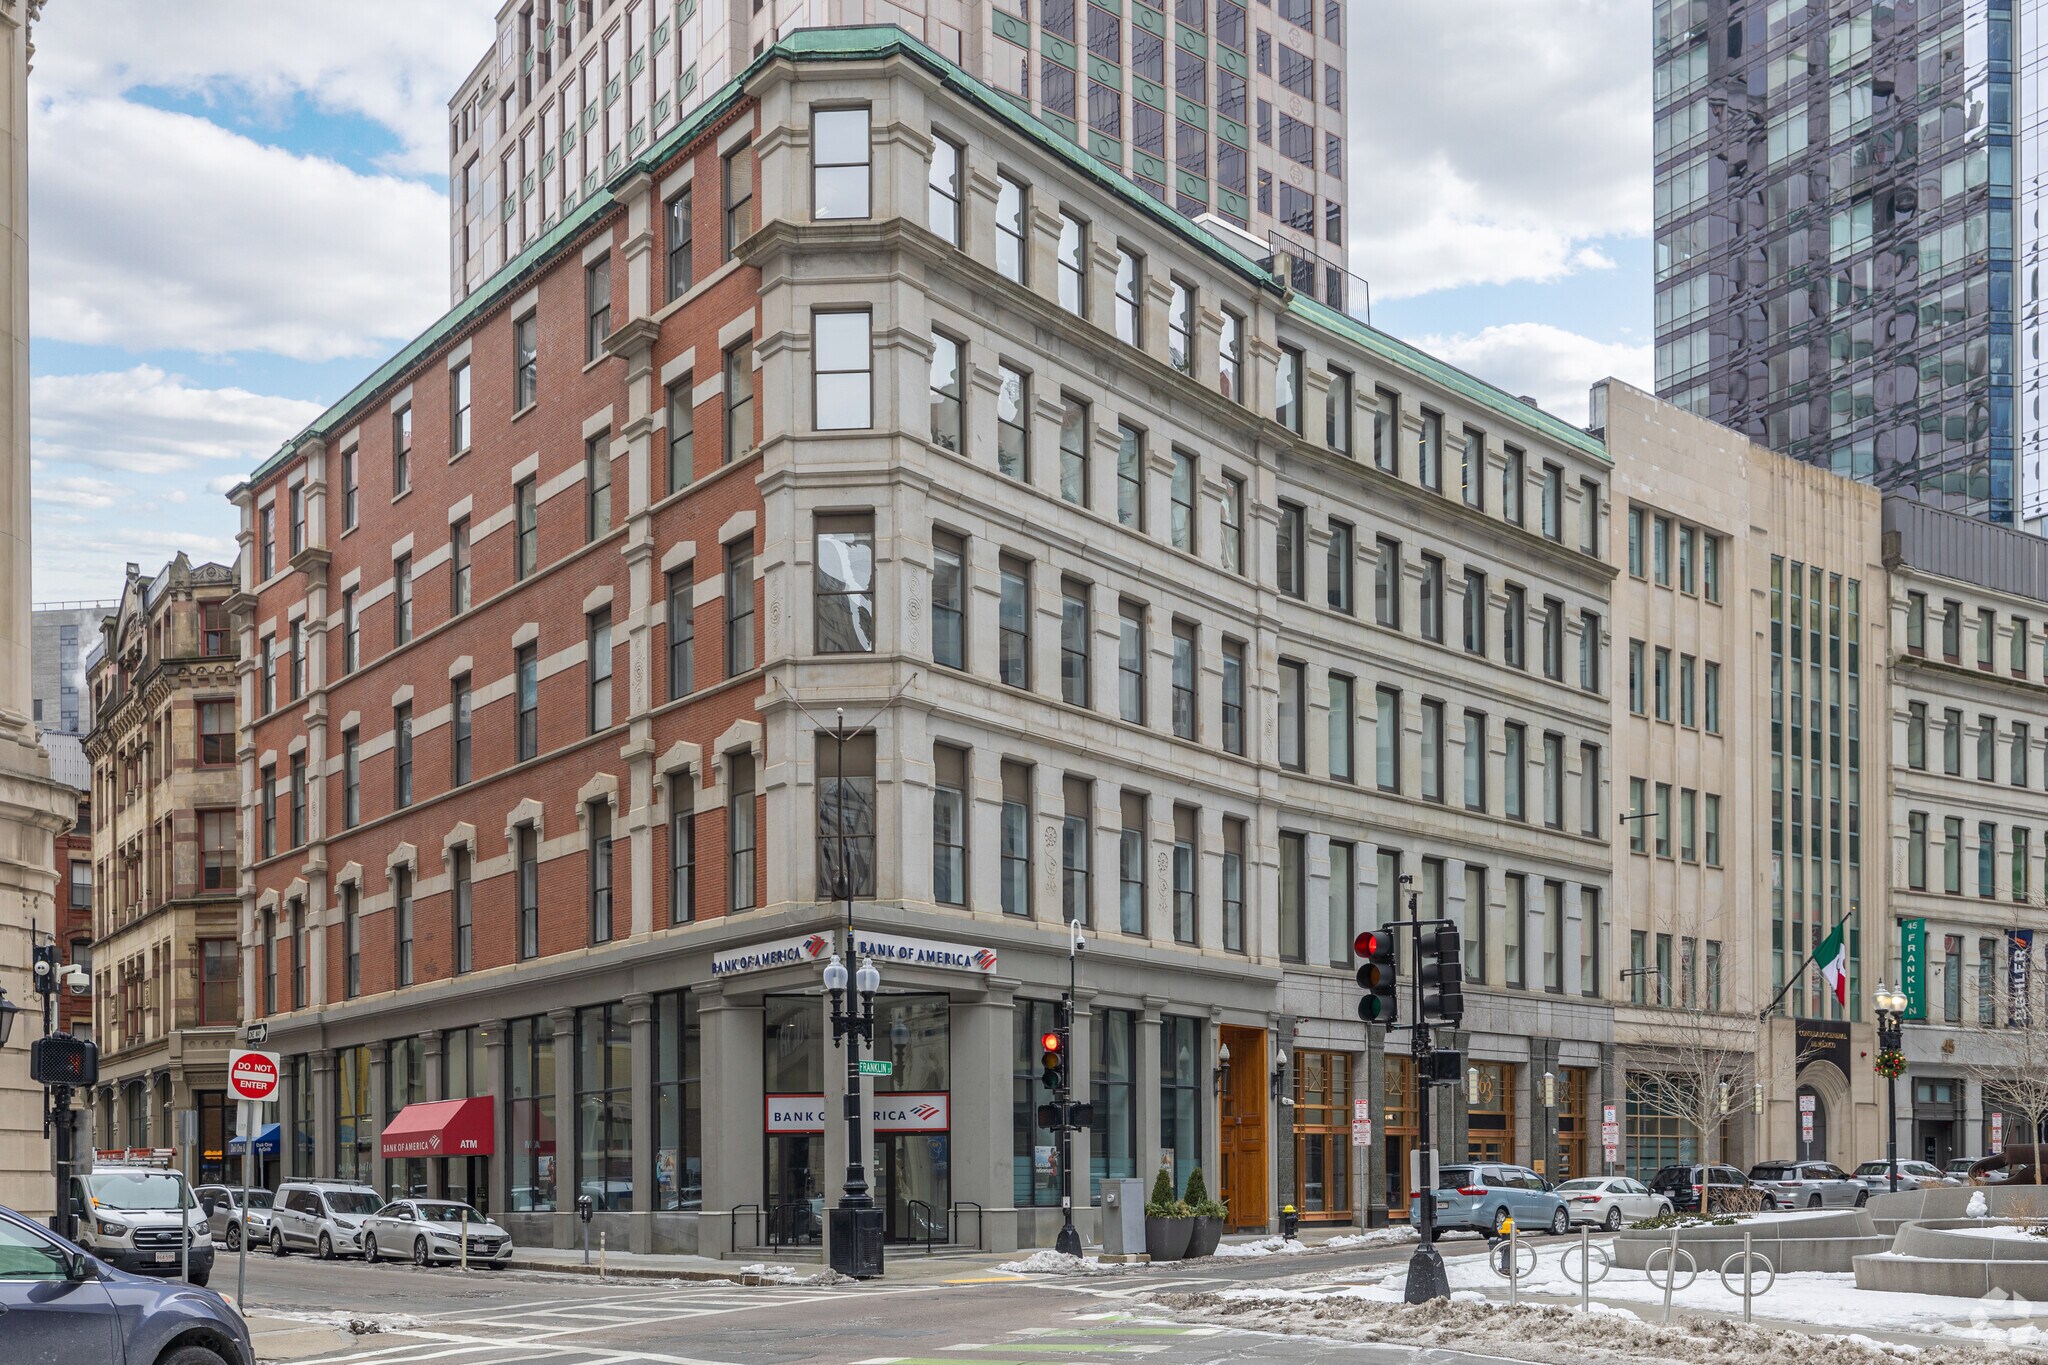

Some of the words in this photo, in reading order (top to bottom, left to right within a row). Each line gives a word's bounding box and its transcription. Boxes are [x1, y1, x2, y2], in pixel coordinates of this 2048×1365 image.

[860, 941, 895, 957] BANK
[898, 946, 914, 959] OF
[917, 949, 972, 967] AMERICA
[712, 960, 737, 974] BANK
[740, 956, 752, 968] OF
[754, 947, 801, 966] AMERICA
[1907, 934, 1917, 1015] FRANKLIN
[238, 1062, 251, 1071] DO
[254, 1063, 272, 1073] NOT
[859, 1062, 886, 1073] FRANKLIN
[240, 1080, 267, 1090] ENTER
[774, 1112, 814, 1122] BANK
[873, 1110, 907, 1121] RICA
[383, 1144, 397, 1153] BANK
[397, 1143, 405, 1151] OF
[404, 1141, 429, 1151] AMERICA
[460, 1140, 478, 1149] ATM
